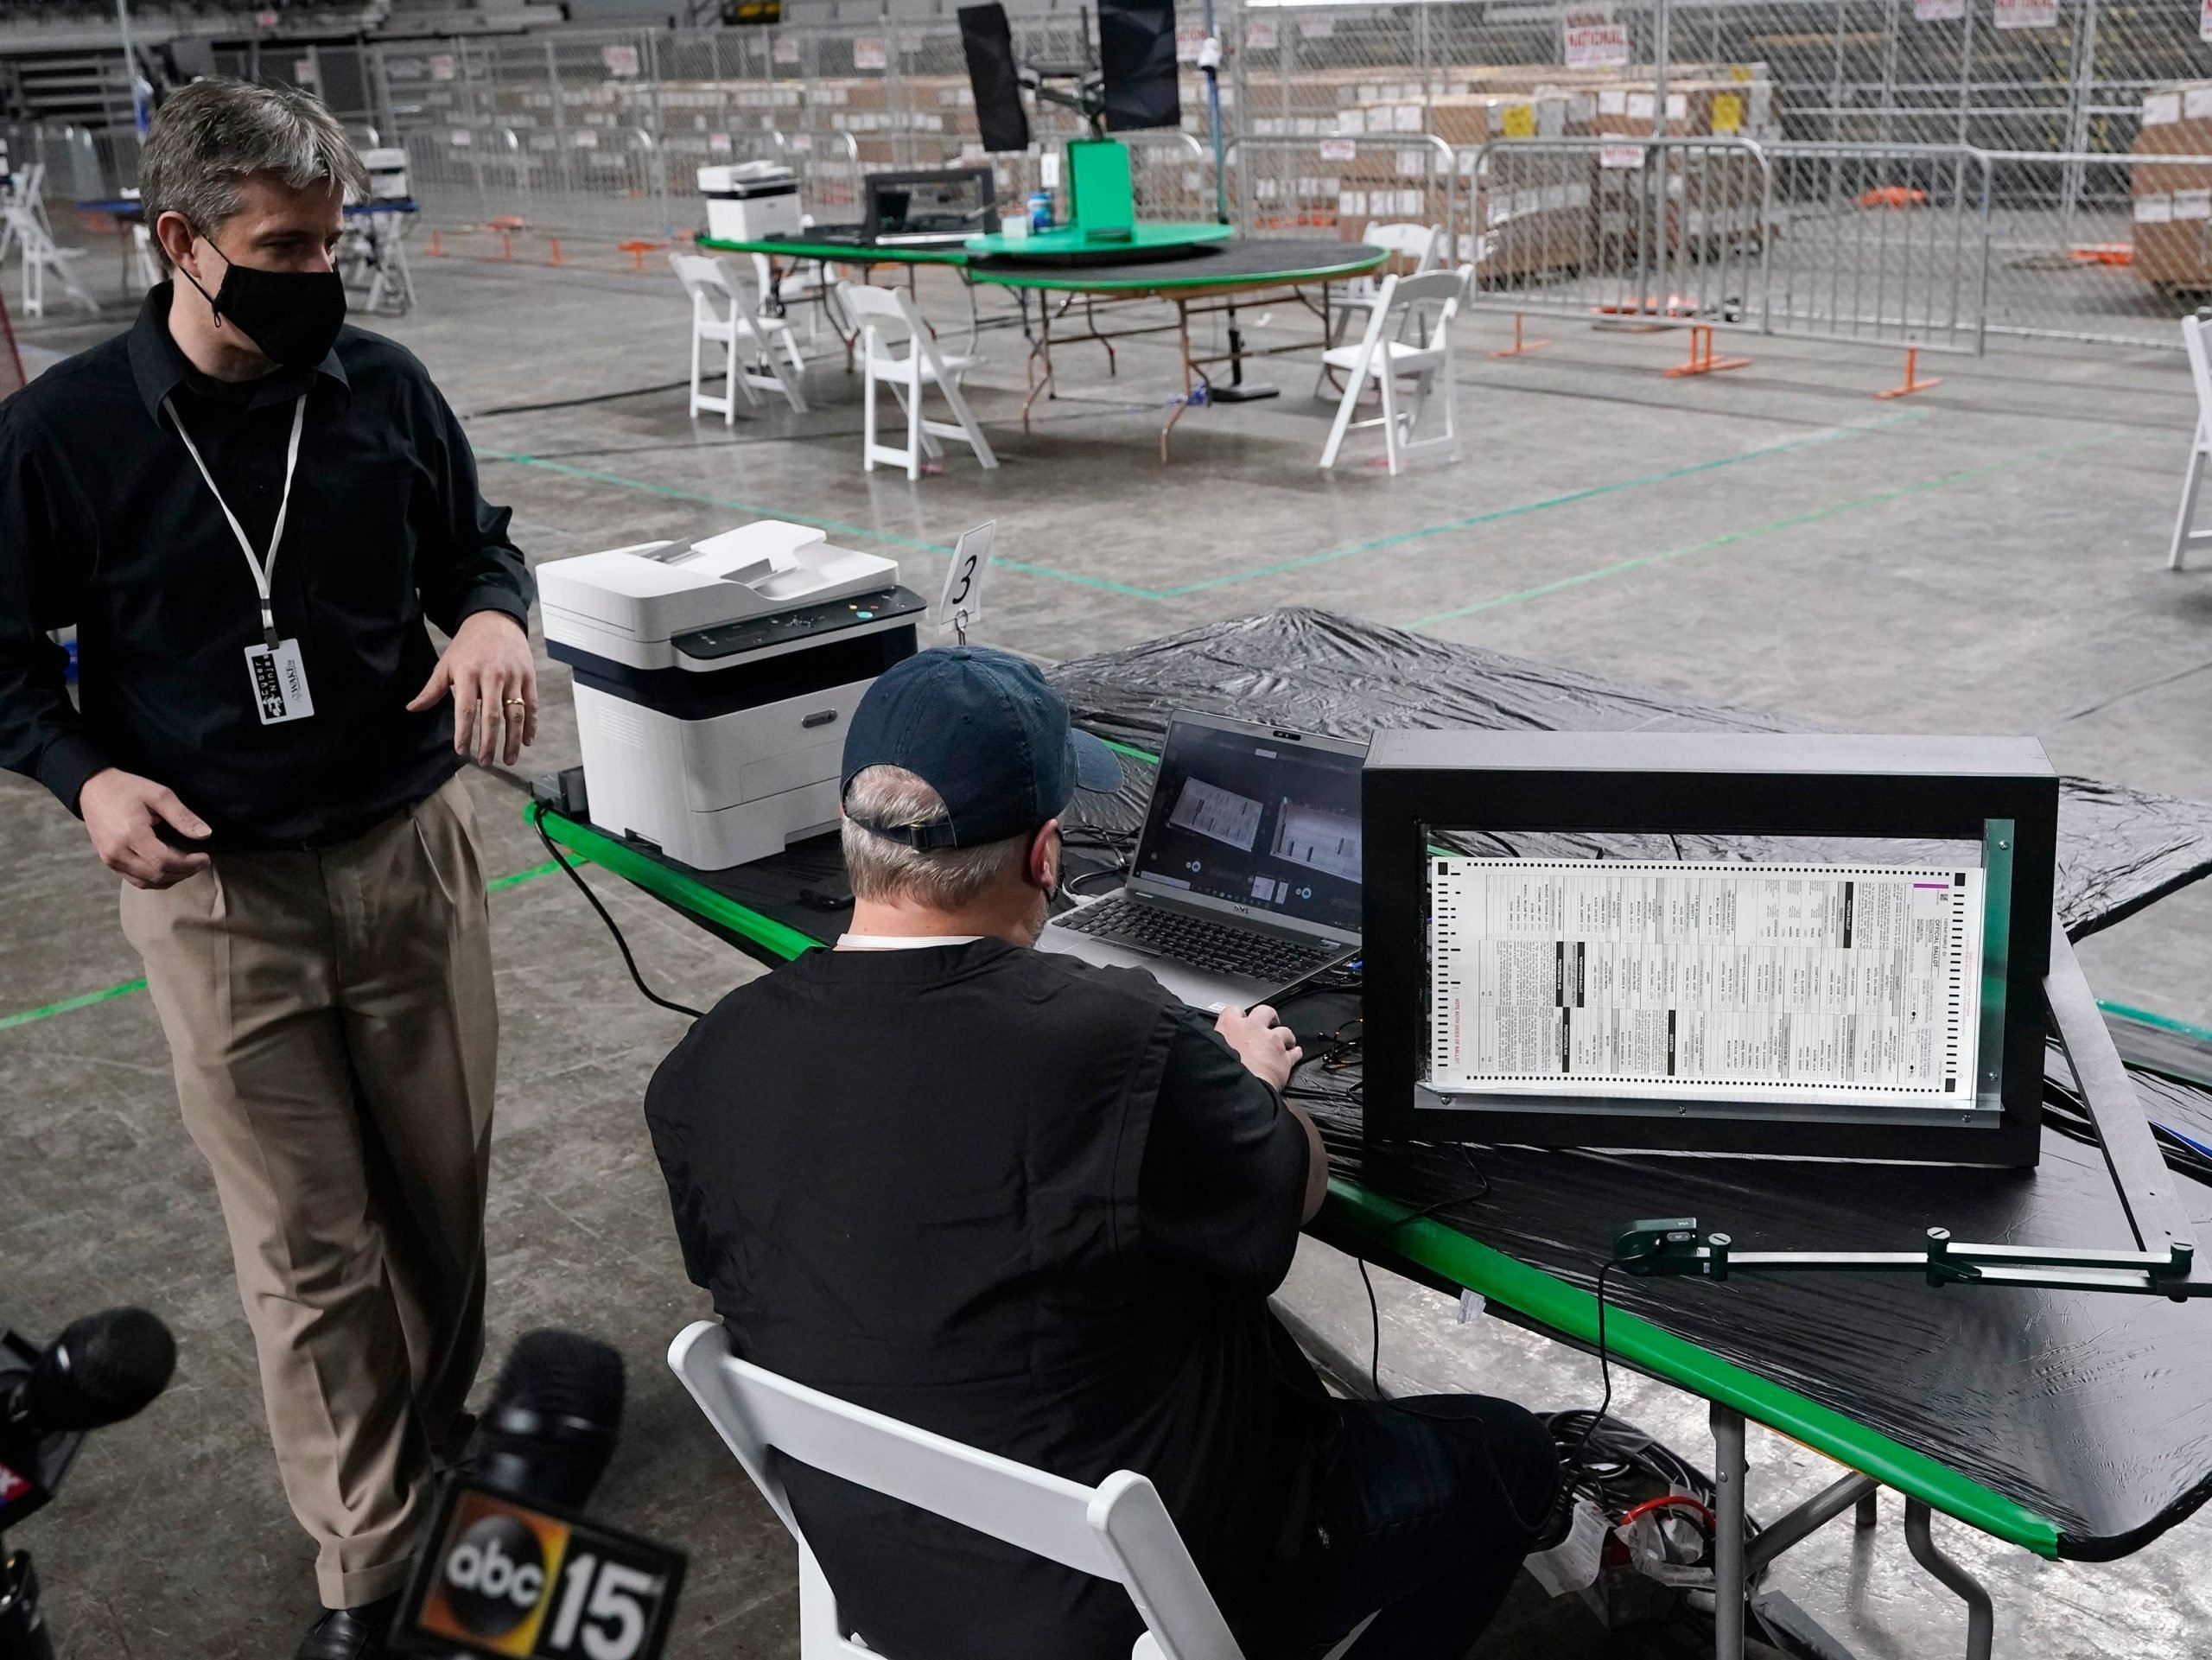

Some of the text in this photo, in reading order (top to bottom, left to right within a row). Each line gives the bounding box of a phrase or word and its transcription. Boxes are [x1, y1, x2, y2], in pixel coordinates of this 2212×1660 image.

[952, 554, 978, 605] 3
[255, 661, 270, 697] Cyber
[1453, 1037, 1459, 1046] OF
[446, 1537, 666, 1660] abc 15
